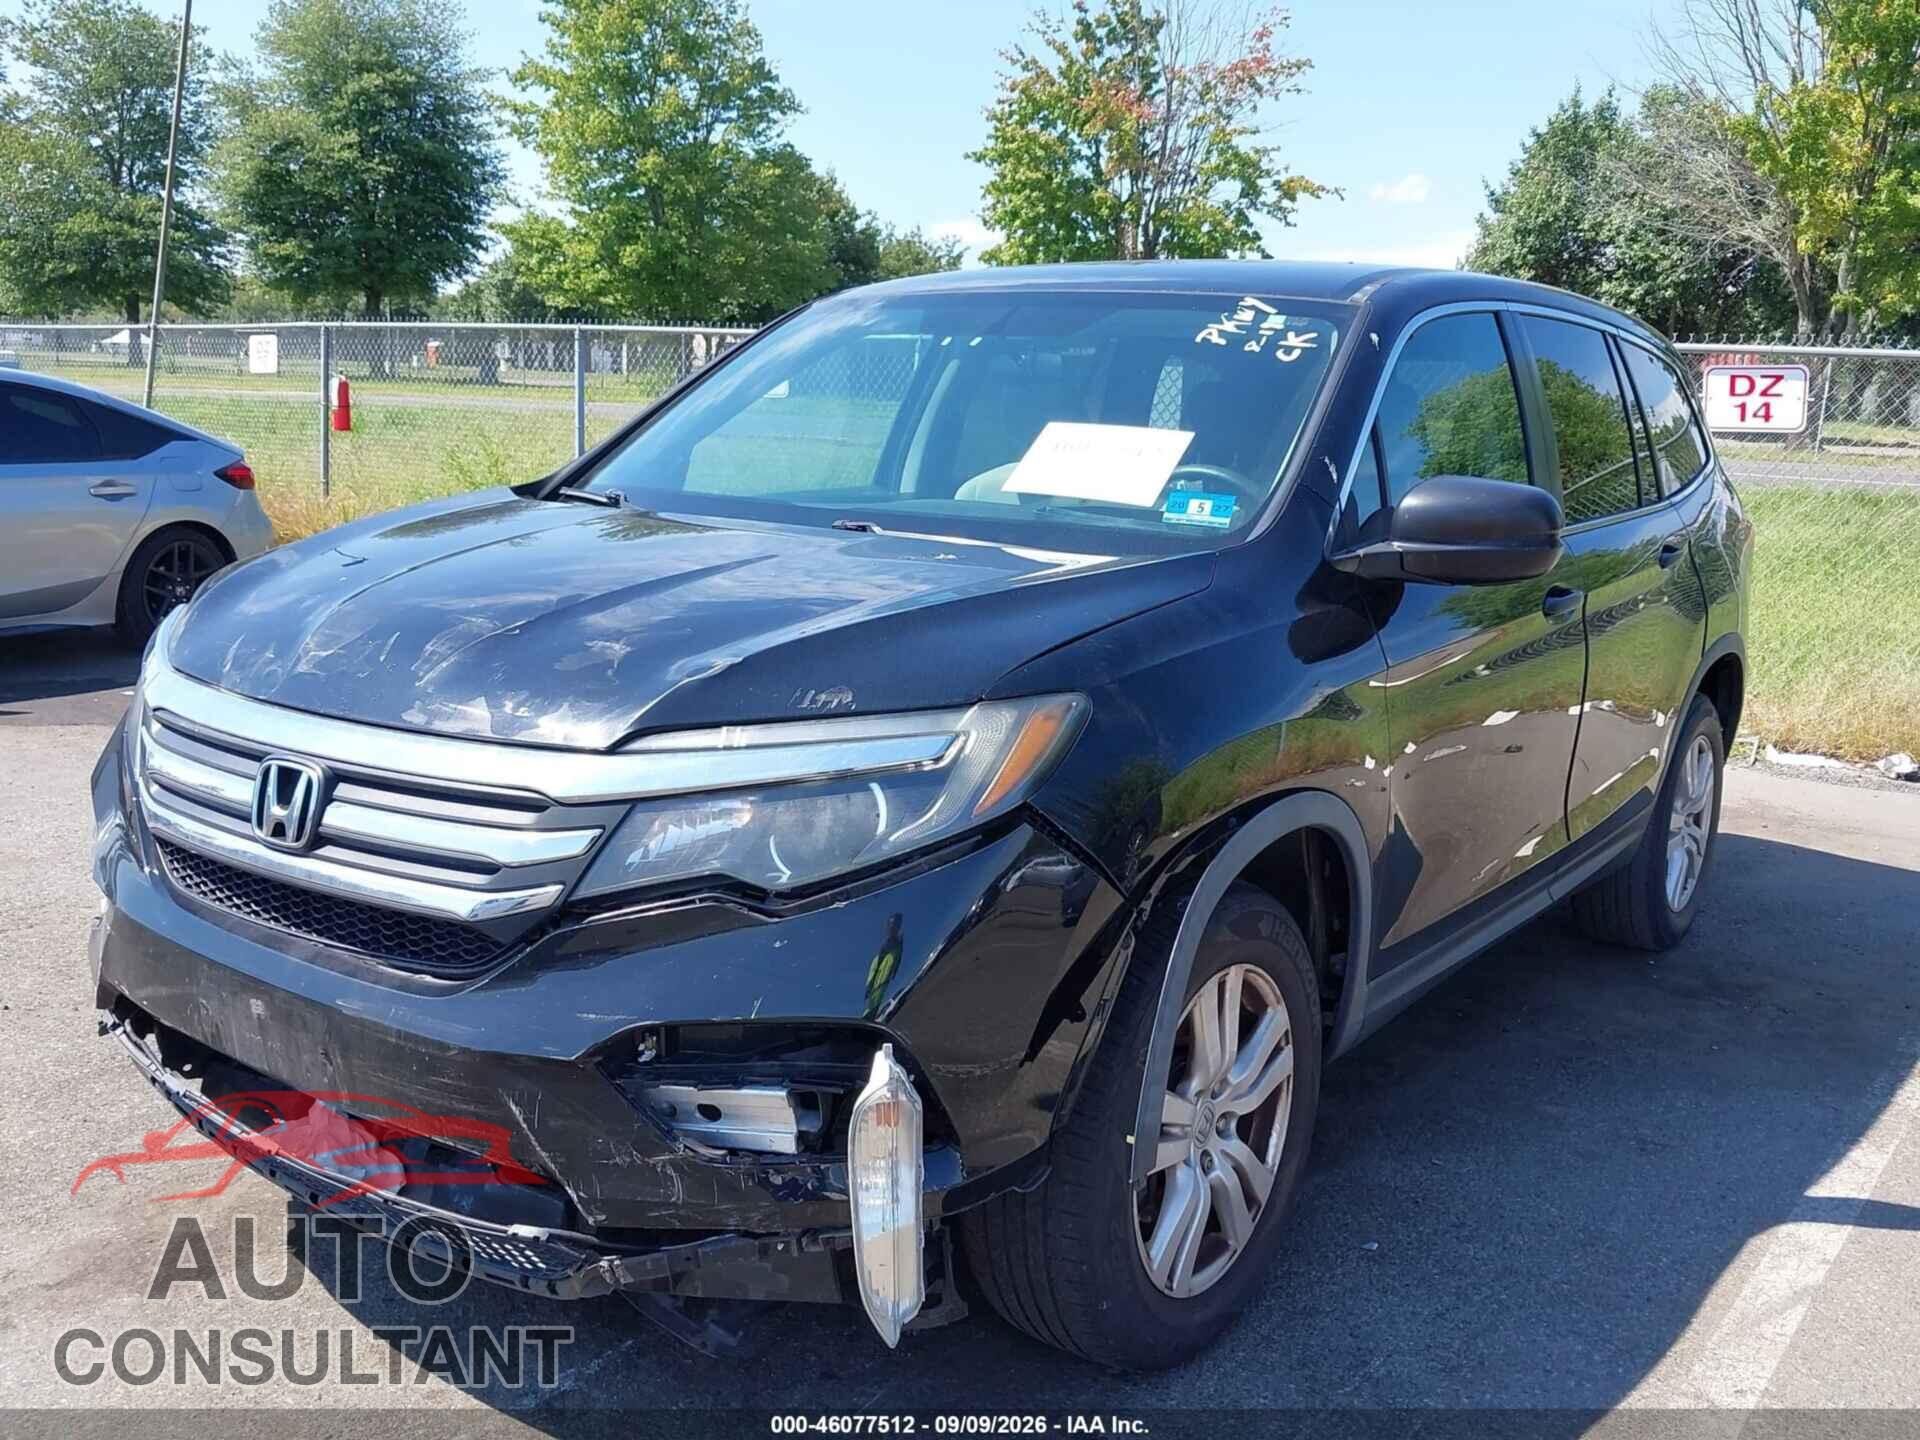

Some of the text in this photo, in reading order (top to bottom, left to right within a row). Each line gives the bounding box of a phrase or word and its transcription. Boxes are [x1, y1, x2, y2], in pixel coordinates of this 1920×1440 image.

[1729, 374, 1785, 398] DZ
[1733, 402, 1774, 423] 14
[1196, 502, 1207, 514] 5
